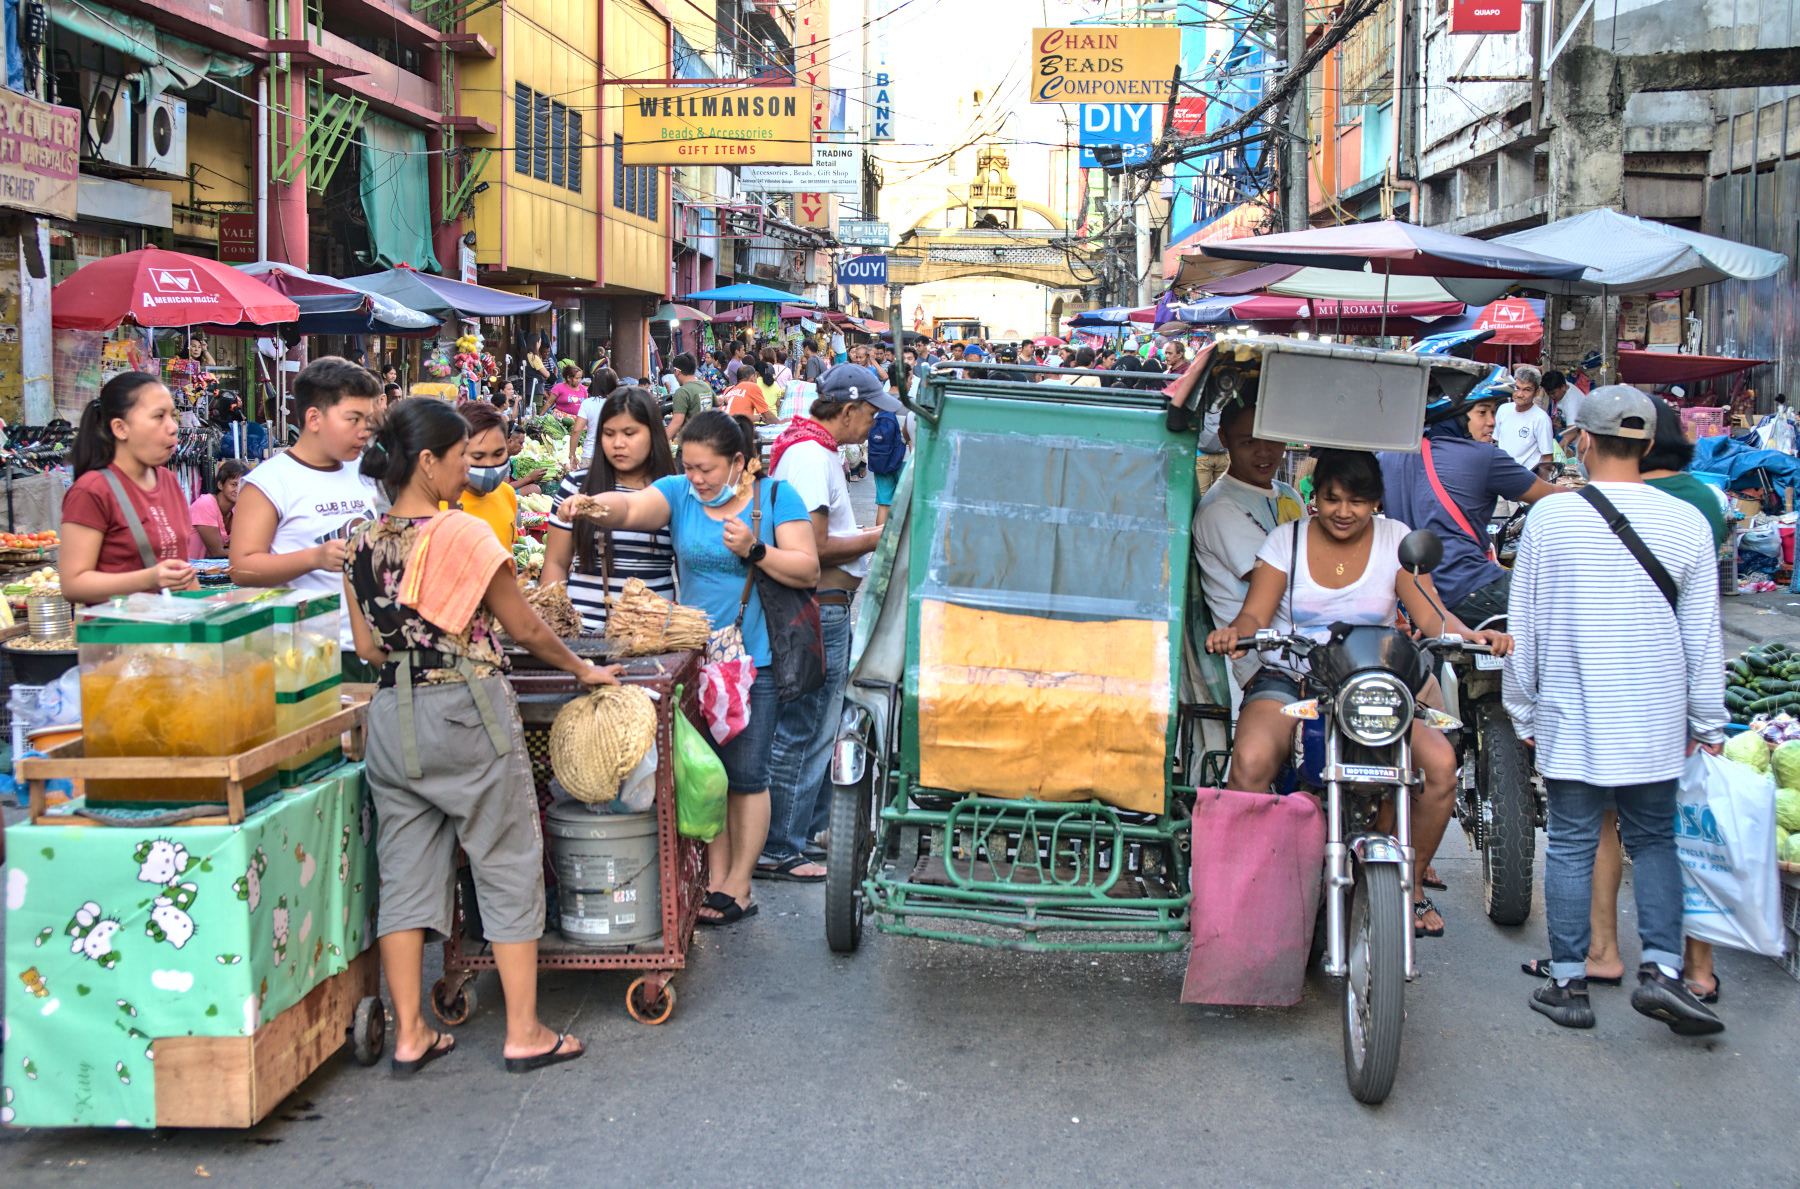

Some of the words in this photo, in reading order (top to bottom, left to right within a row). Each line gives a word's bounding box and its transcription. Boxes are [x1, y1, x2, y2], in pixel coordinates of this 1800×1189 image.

[1040, 29, 1118, 54] CHAIN
[1039, 55, 1124, 76] BEADS
[1040, 75, 1174, 100] COMPONENTS
[639, 96, 796, 117] WELLMANSON
[876, 73, 890, 136] BANK
[13, 103, 77, 147] CENTER
[1084, 103, 1148, 132] DIY
[661, 127, 693, 139] Beads
[697, 127, 705, 139] &
[709, 128, 773, 139] Accessories
[678, 145, 709, 155] GIFT
[715, 145, 756, 155] ITEMS
[817, 149, 853, 157] TRADING
[1084, 143, 1148, 158] BDS
[19, 141, 79, 175] MATERIALS
[832, 169, 849, 178] Shop
[222, 228, 254, 238] VALE
[223, 246, 255, 254] COMM
[840, 262, 885, 277] YOUYI
[143, 292, 192, 307] AMERICAN
[848, 386, 859, 400] 3
[315, 501, 339, 513] CLUB
[340, 501, 348, 510] R
[1346, 768, 1395, 777] MOTORSTAR
[968, 804, 1097, 886] KAGI
